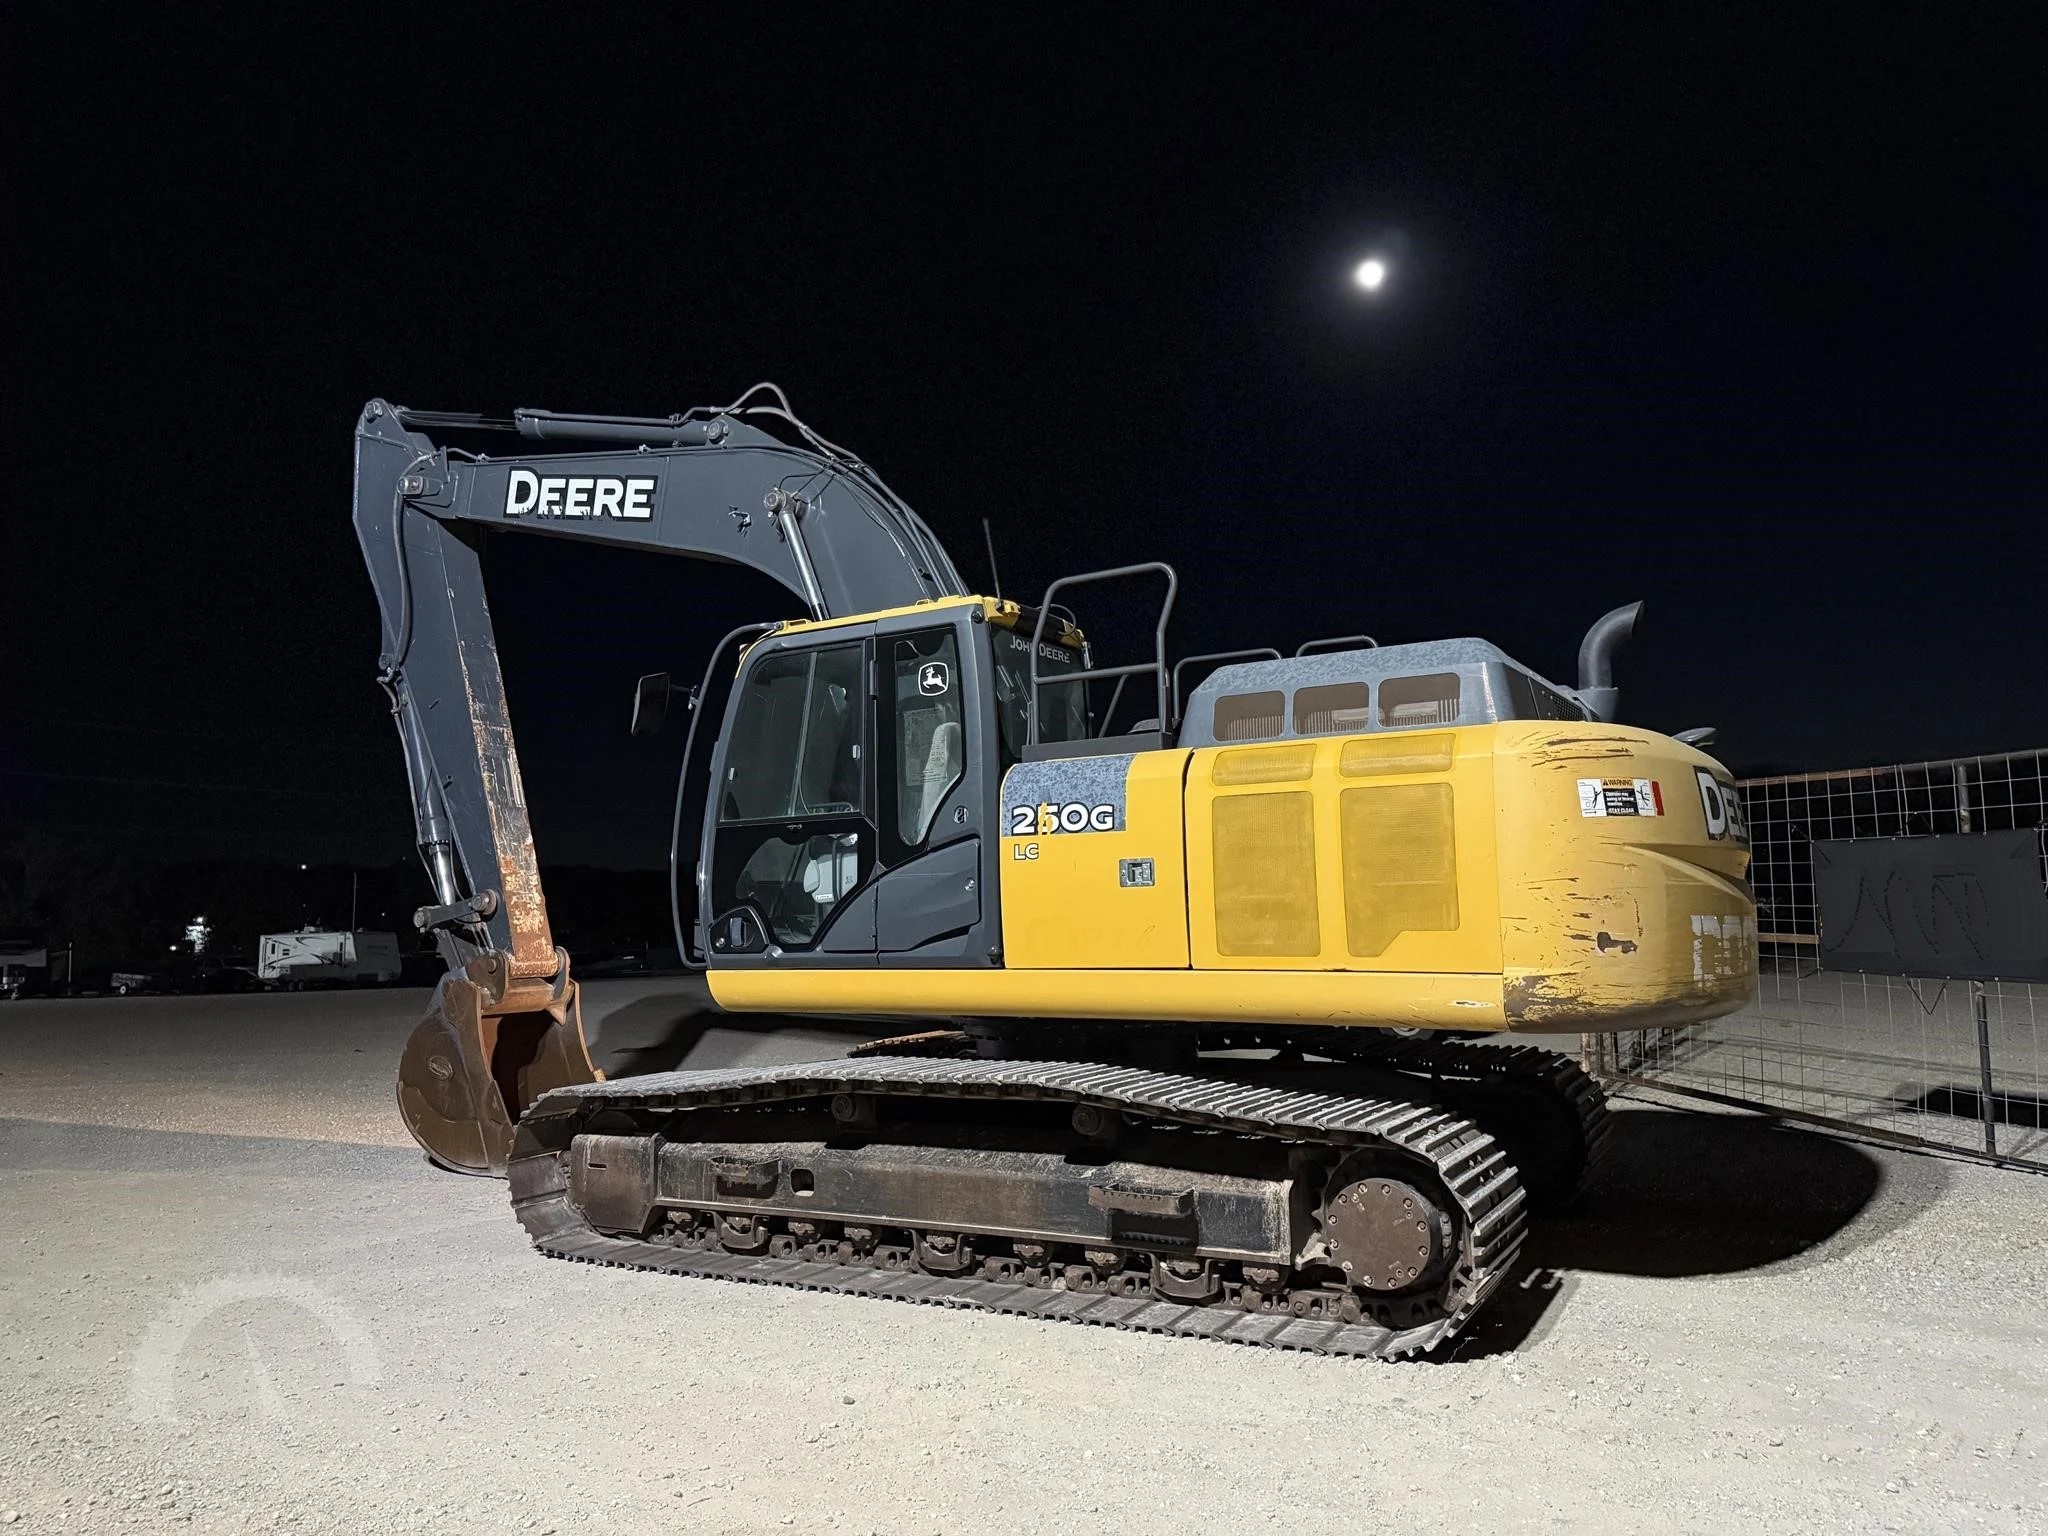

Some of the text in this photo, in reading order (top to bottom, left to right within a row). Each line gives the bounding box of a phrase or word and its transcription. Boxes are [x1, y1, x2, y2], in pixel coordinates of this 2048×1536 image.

[505, 469, 656, 519] DEERE
[1010, 635, 1032, 653] JOH
[1013, 843, 1039, 860] LC
